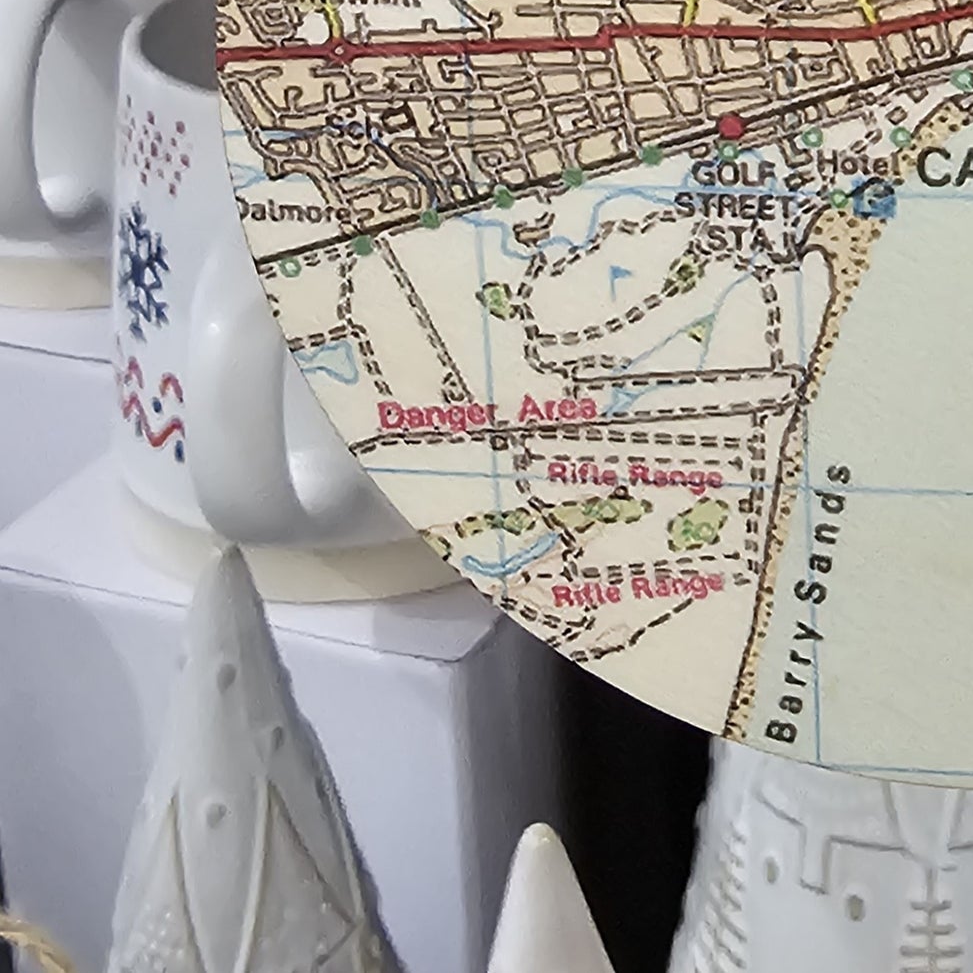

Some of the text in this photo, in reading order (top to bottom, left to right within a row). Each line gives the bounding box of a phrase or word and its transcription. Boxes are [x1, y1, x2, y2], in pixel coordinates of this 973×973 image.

[691, 159, 777, 187] GOLF
[816, 148, 901, 177] Hotel
[674, 191, 796, 221] STREET
[377, 393, 599, 433] Danger Area
[547, 461, 725, 495] Rifle Range
[551, 572, 726, 608] Rifle Range
[764, 463, 852, 745] Barry Sands
